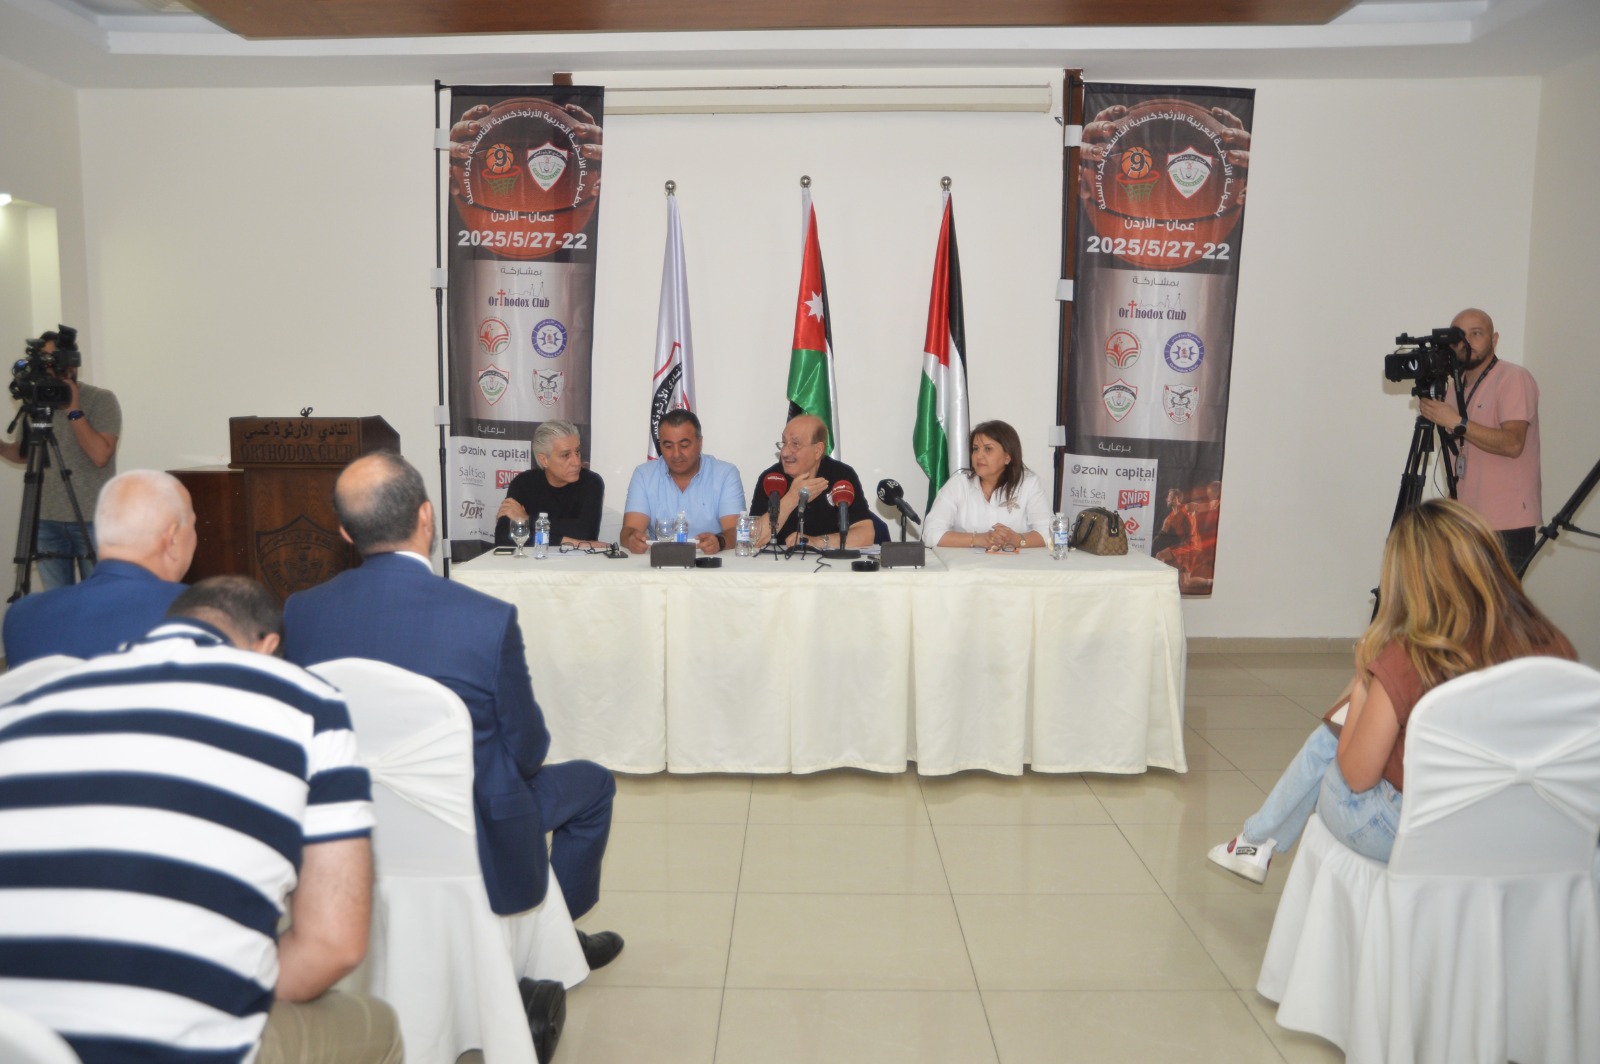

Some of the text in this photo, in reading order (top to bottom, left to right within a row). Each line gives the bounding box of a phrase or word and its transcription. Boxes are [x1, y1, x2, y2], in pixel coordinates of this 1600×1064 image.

[492, 107, 543, 126] الأرثوذكسية
[543, 111, 571, 135] العربية
[1129, 109, 1186, 127] الأرثوذكسية
[1186, 114, 1217, 139] العربية
[467, 122, 492, 155] التاسعة
[1101, 124, 1130, 158] التاسعة
[463, 155, 474, 177] بكرة
[494, 147, 508, 168] 9
[1130, 152, 1145, 172] 9
[1095, 158, 1107, 180] بكرة
[463, 178, 474, 205] السلة
[571, 170, 588, 208] بطولة
[1095, 182, 1106, 210] السلة
[1214, 177, 1234, 217] بطولة
[491, 209, 519, 223] الأردن
[528, 211, 555, 223] عمان
[1124, 216, 1156, 230] الأردن
[1166, 219, 1195, 231] عمان
[457, 230, 588, 250] 2025/5/27-22
[1086, 235, 1231, 260] 2025/5/27-22
[500, 265, 543, 277] بمشاركة
[1132, 275, 1180, 288] بمشاركة
[488, 289, 550, 308] Orthodox Club
[1118, 300, 1187, 321] Orthodox Club
[477, 423, 506, 435] برعاية
[240, 443, 353, 461] ORTHODOX CLUB
[491, 449, 529, 461] capital
[1098, 441, 1132, 453] برعاية
[1115, 467, 1155, 480] capital
[1070, 486, 1106, 500] Salt Sea
